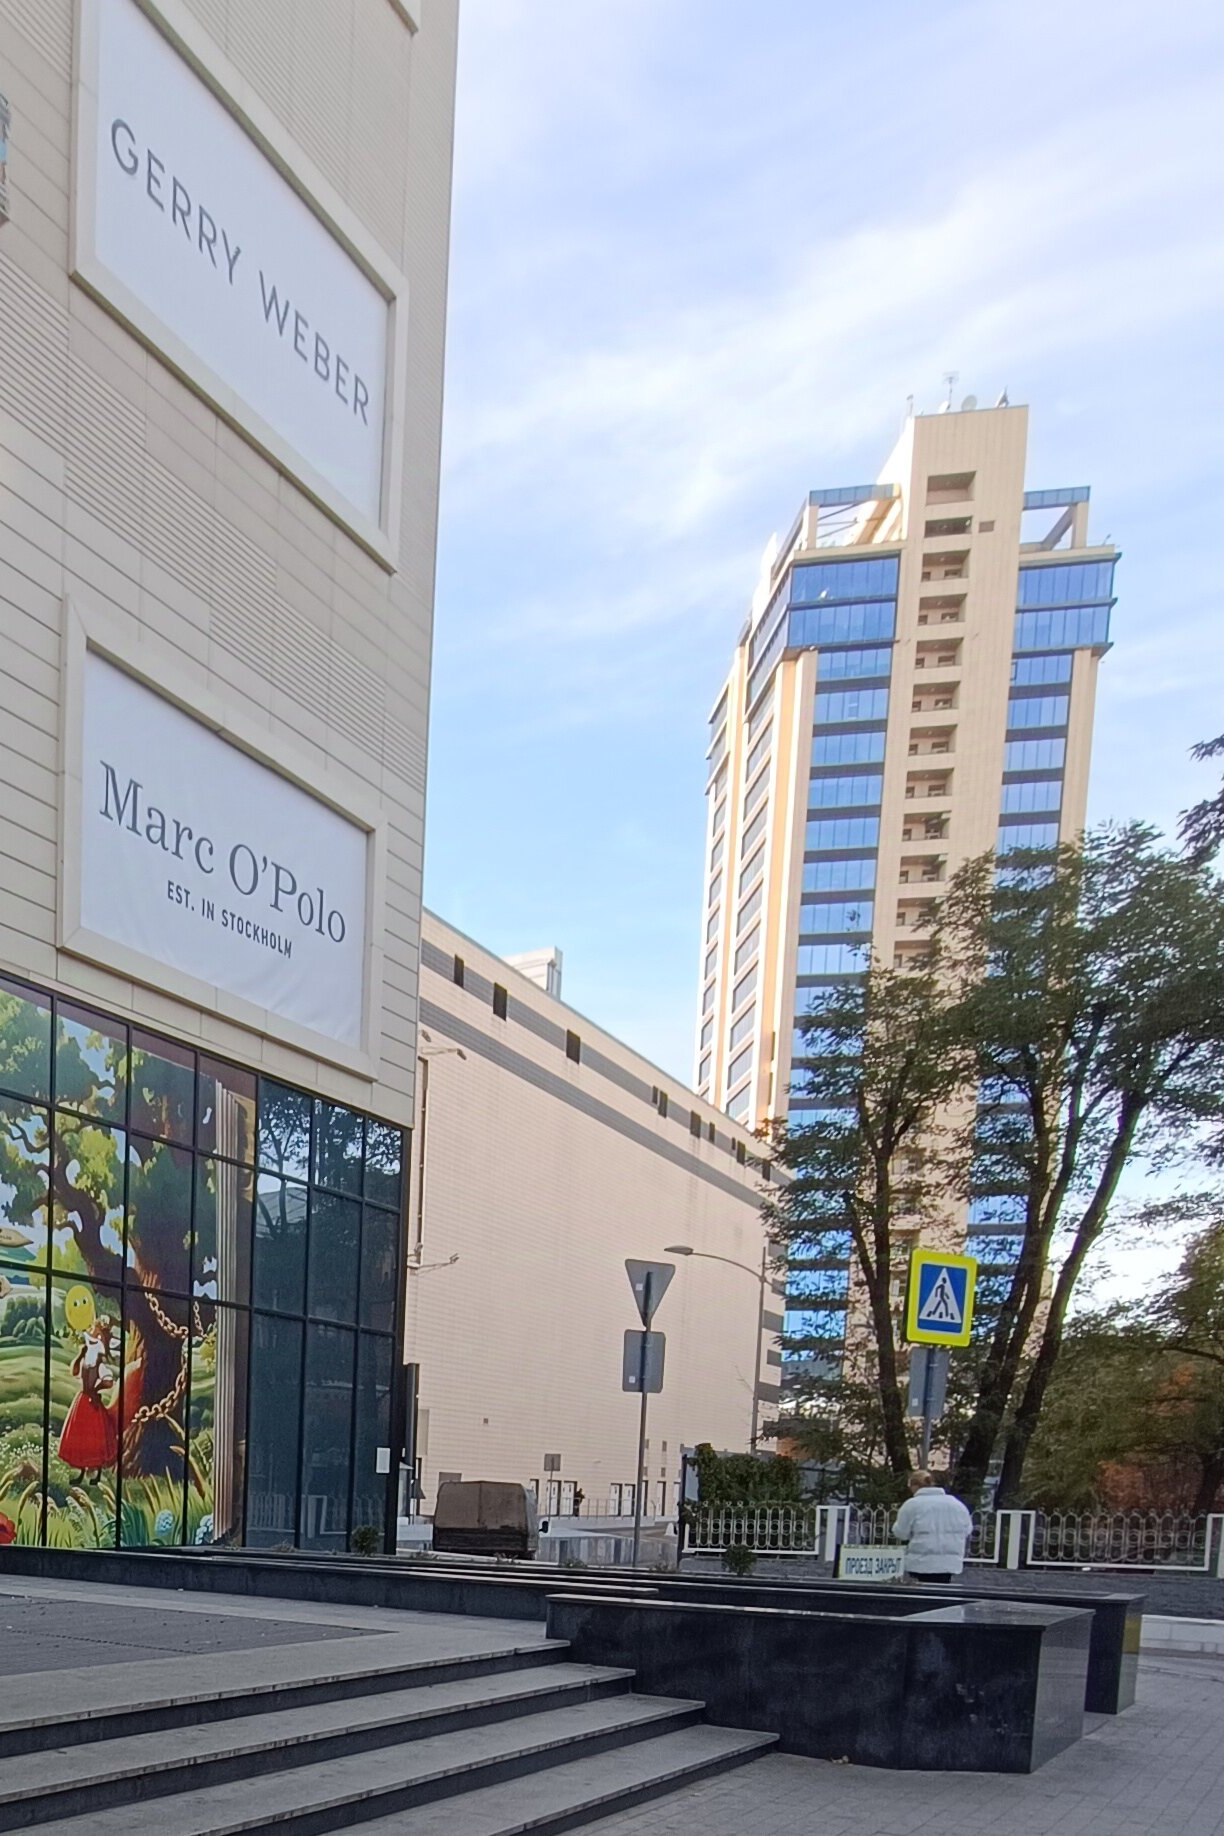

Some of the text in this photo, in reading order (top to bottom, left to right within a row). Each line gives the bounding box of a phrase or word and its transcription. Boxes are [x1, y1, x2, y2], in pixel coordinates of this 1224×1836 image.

[110, 117, 370, 426] GERRY WEBER
[98, 759, 215, 875] Marc
[167, 880, 293, 960] EST. IN STOCKHOLM
